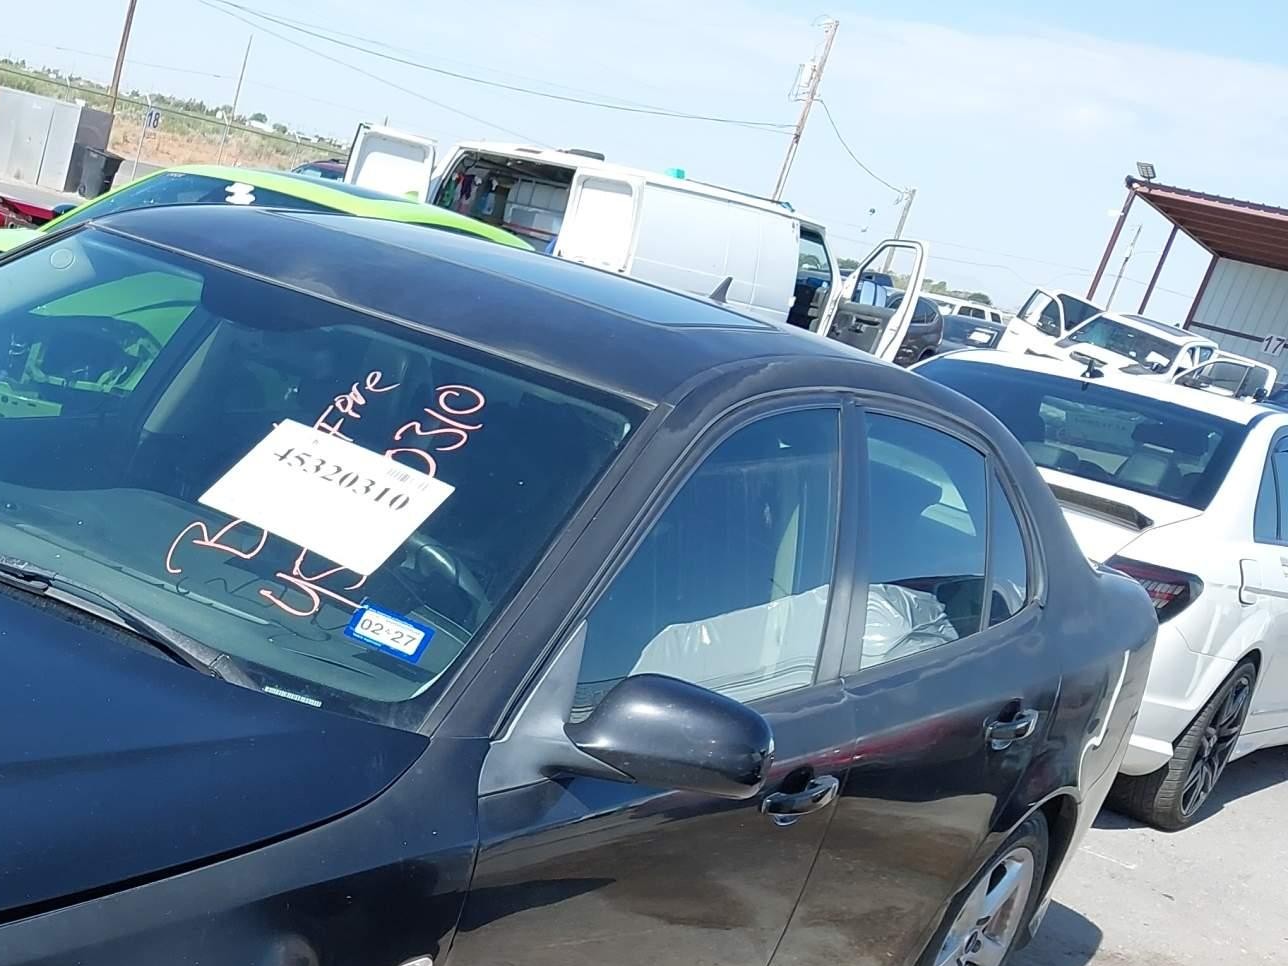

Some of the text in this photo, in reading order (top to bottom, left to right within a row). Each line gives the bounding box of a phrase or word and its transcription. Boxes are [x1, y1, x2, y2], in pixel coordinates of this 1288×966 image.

[147, 110, 161, 129] 18
[1264, 335, 1286, 354] 17
[274, 448, 410, 512] 45320310
[360, 618, 417, 647] 02 27
